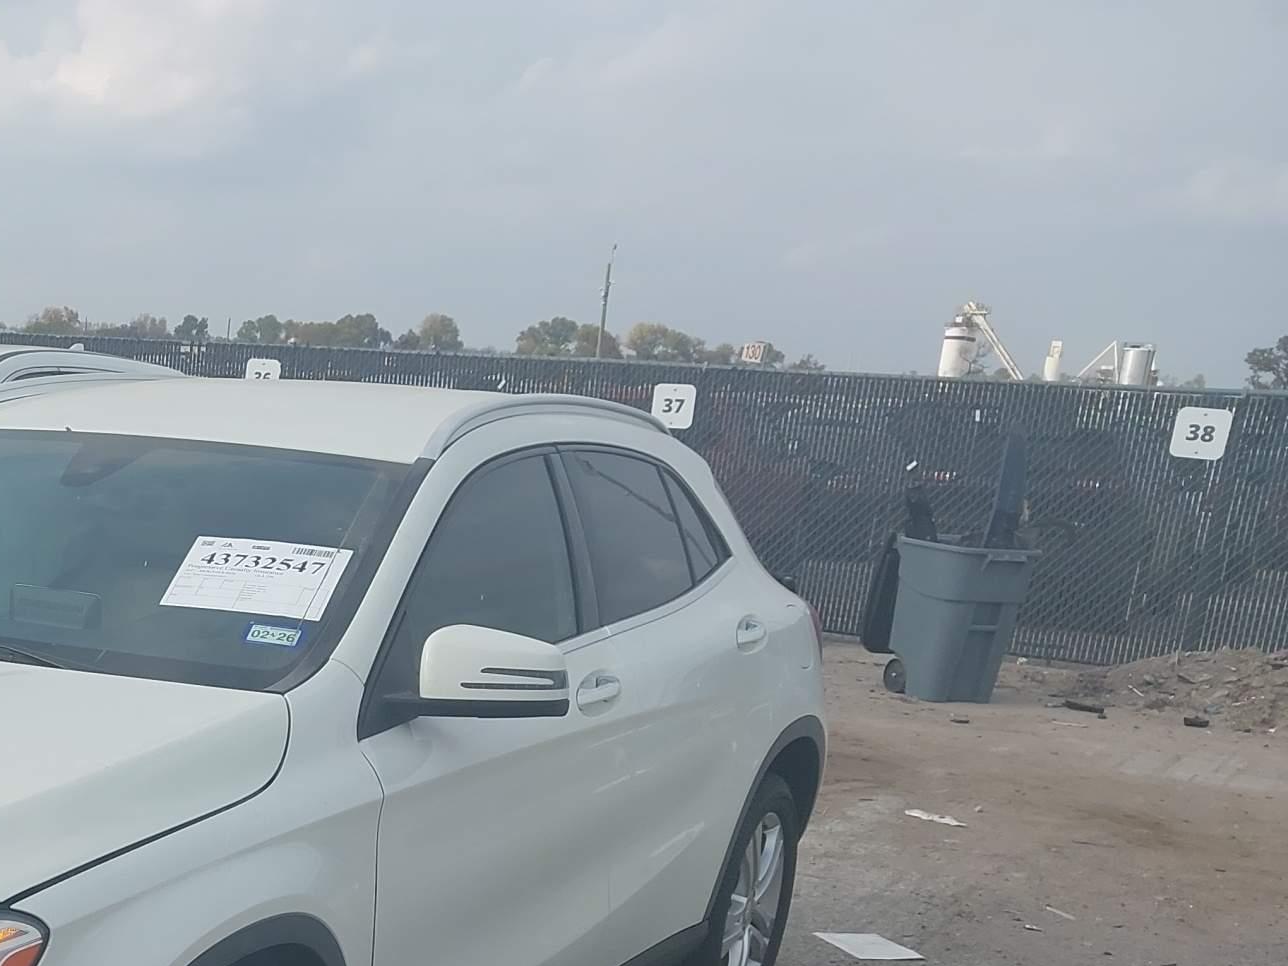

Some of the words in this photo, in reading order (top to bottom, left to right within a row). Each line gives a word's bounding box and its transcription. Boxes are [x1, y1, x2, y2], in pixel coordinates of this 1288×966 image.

[745, 344, 762, 360] 130
[662, 398, 686, 414] 37
[1185, 424, 1216, 443] 38
[200, 552, 326, 575] 43732547
[251, 629, 270, 640] 02
[276, 632, 296, 643] 26
